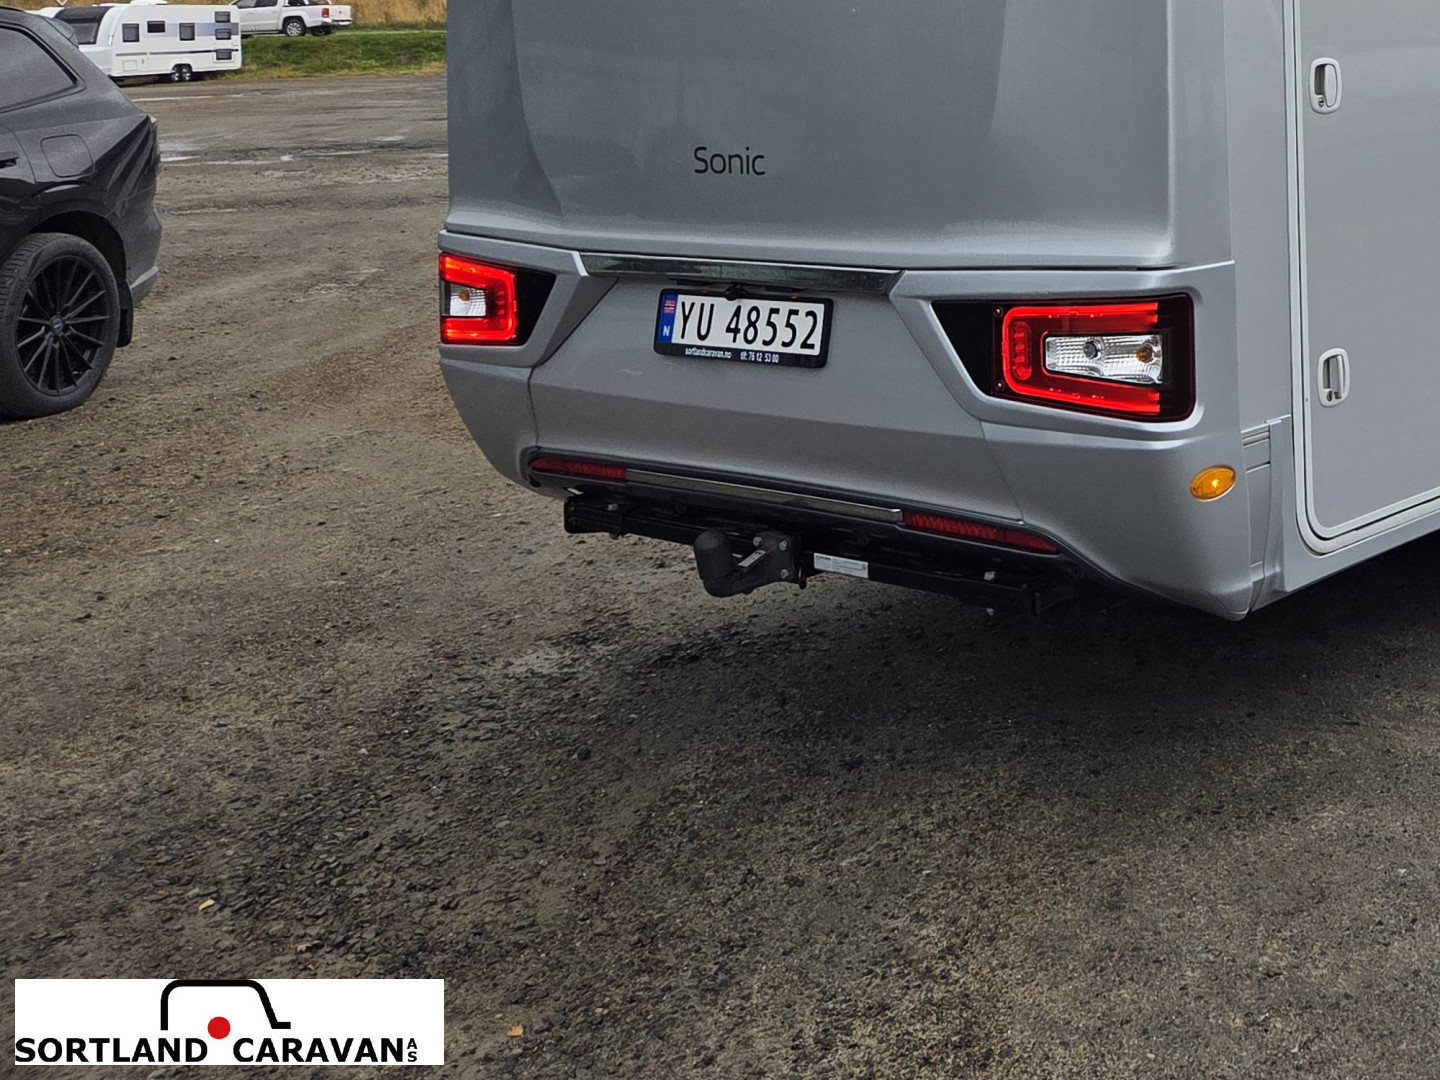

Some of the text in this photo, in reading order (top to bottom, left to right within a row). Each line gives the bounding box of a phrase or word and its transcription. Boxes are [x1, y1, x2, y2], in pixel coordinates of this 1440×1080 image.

[693, 146, 766, 176] Sonic
[662, 325, 671, 337] N
[680, 301, 818, 350] YU 48552
